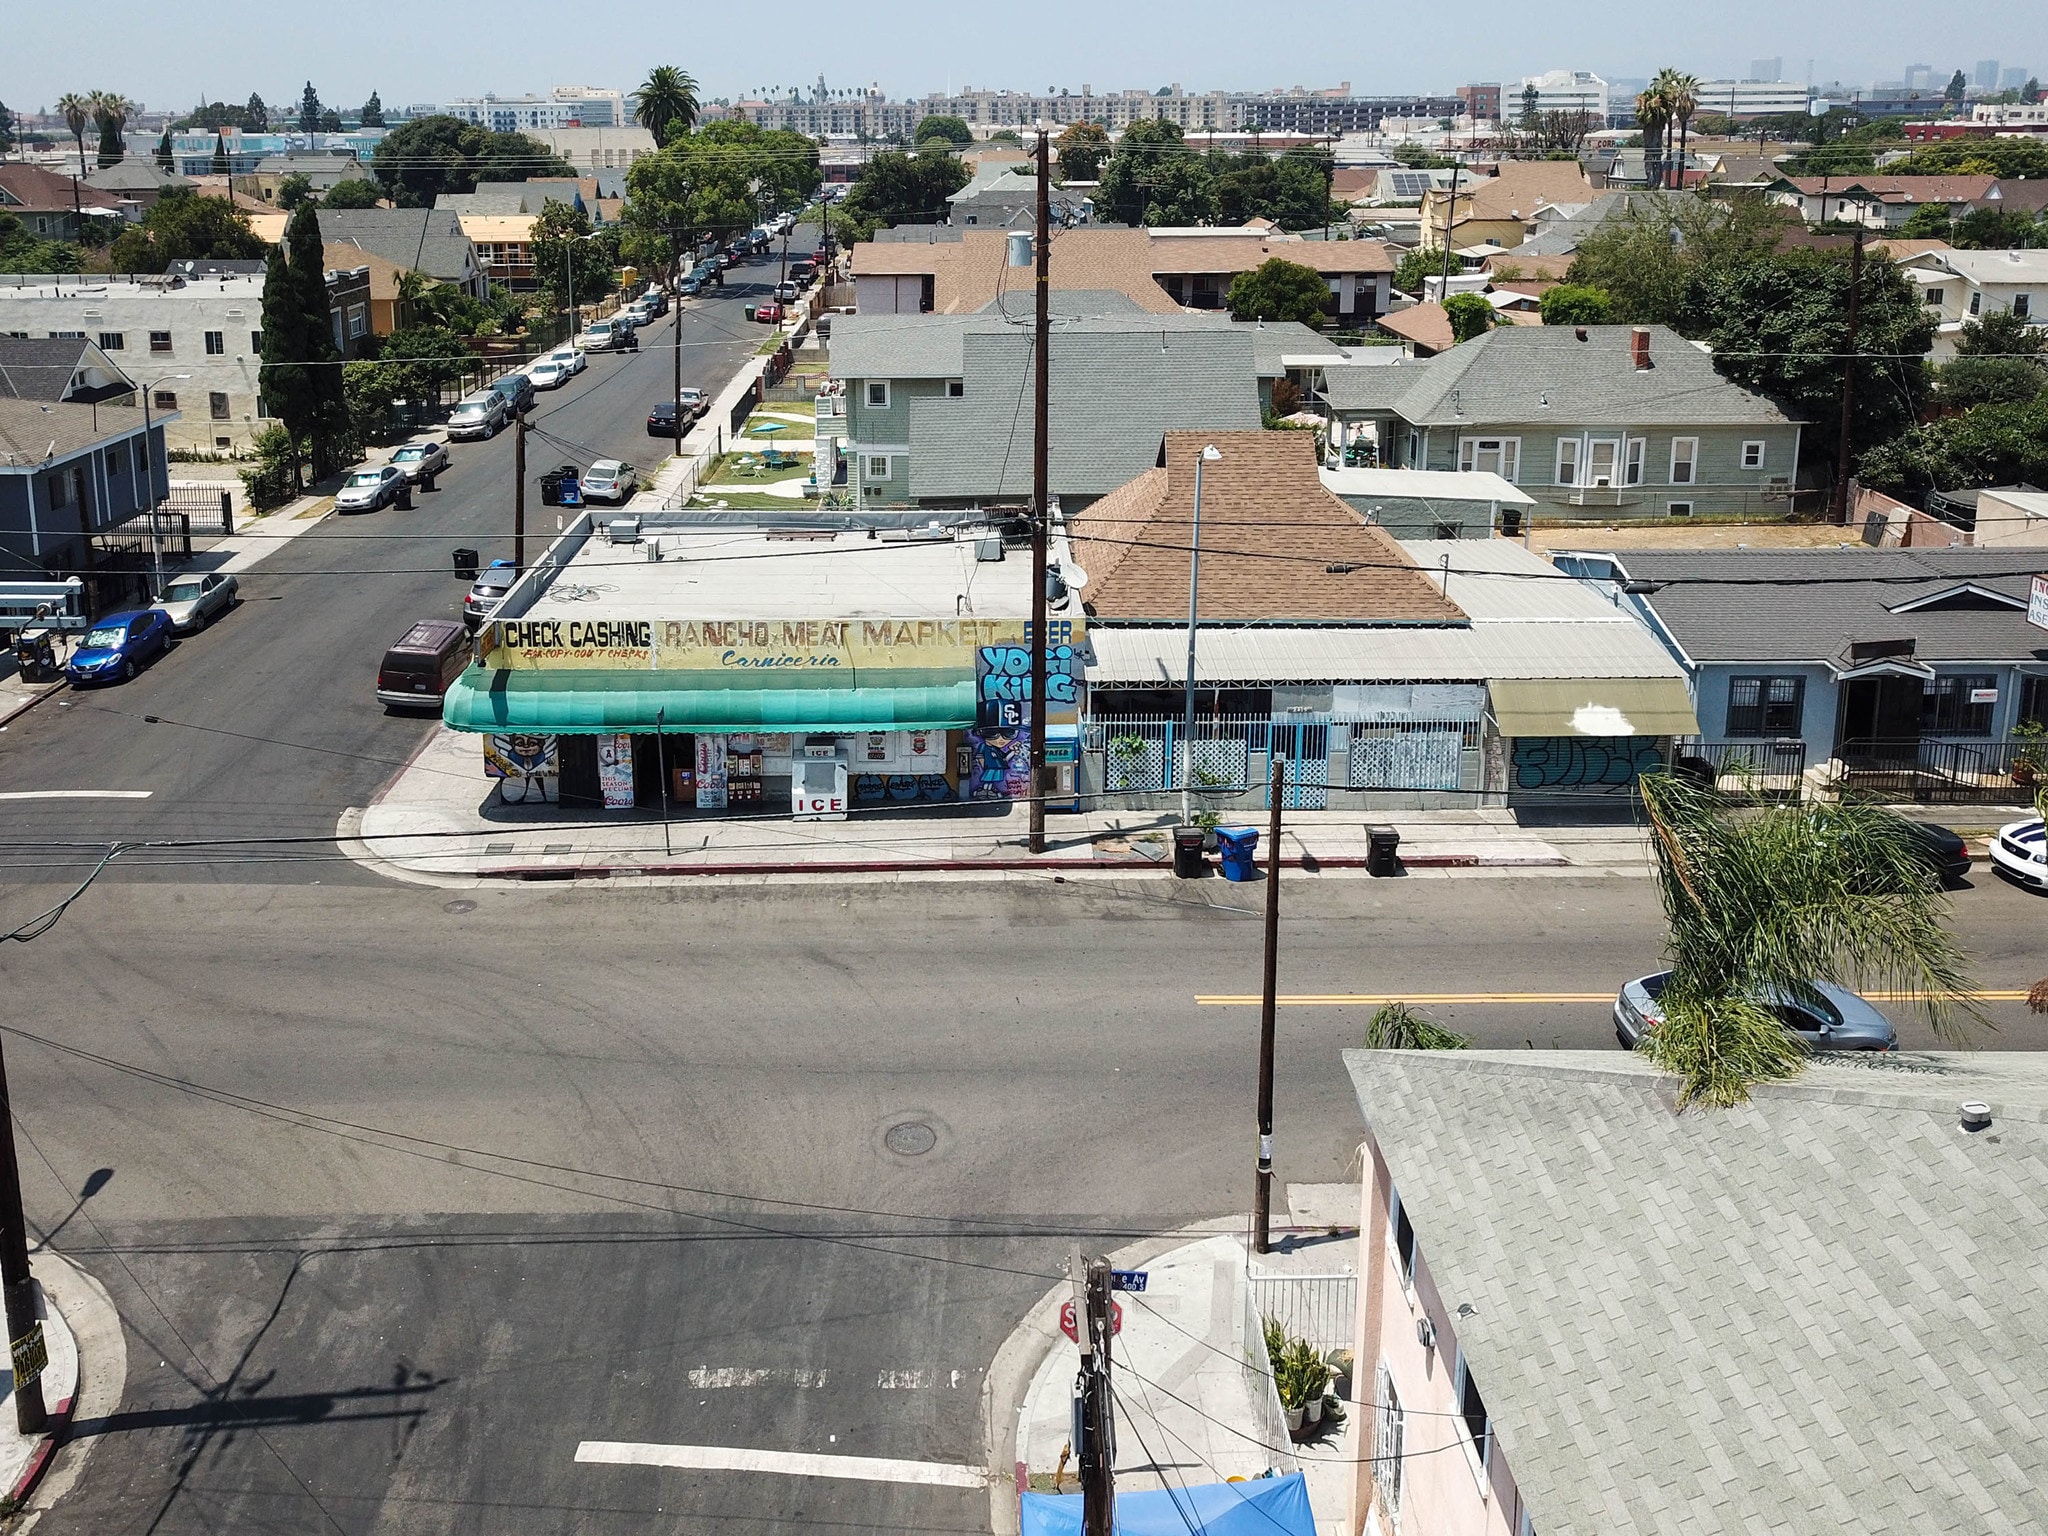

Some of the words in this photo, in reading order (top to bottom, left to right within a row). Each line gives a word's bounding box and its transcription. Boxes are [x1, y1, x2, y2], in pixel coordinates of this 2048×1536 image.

[505, 621, 564, 648] CHECK
[570, 621, 651, 648] CASHING
[665, 621, 769, 647] RANCHO
[782, 621, 850, 647] MEAT
[862, 621, 1001, 647] MARKET
[1023, 620, 1073, 644] BER
[607, 650, 649, 661] CHECKS
[721, 649, 841, 668] Carniceria
[604, 795, 634, 806] Coors
[798, 797, 843, 812] ICE
[1122, 1283, 1137, 1291] 400
[1133, 1274, 1145, 1285] Av
